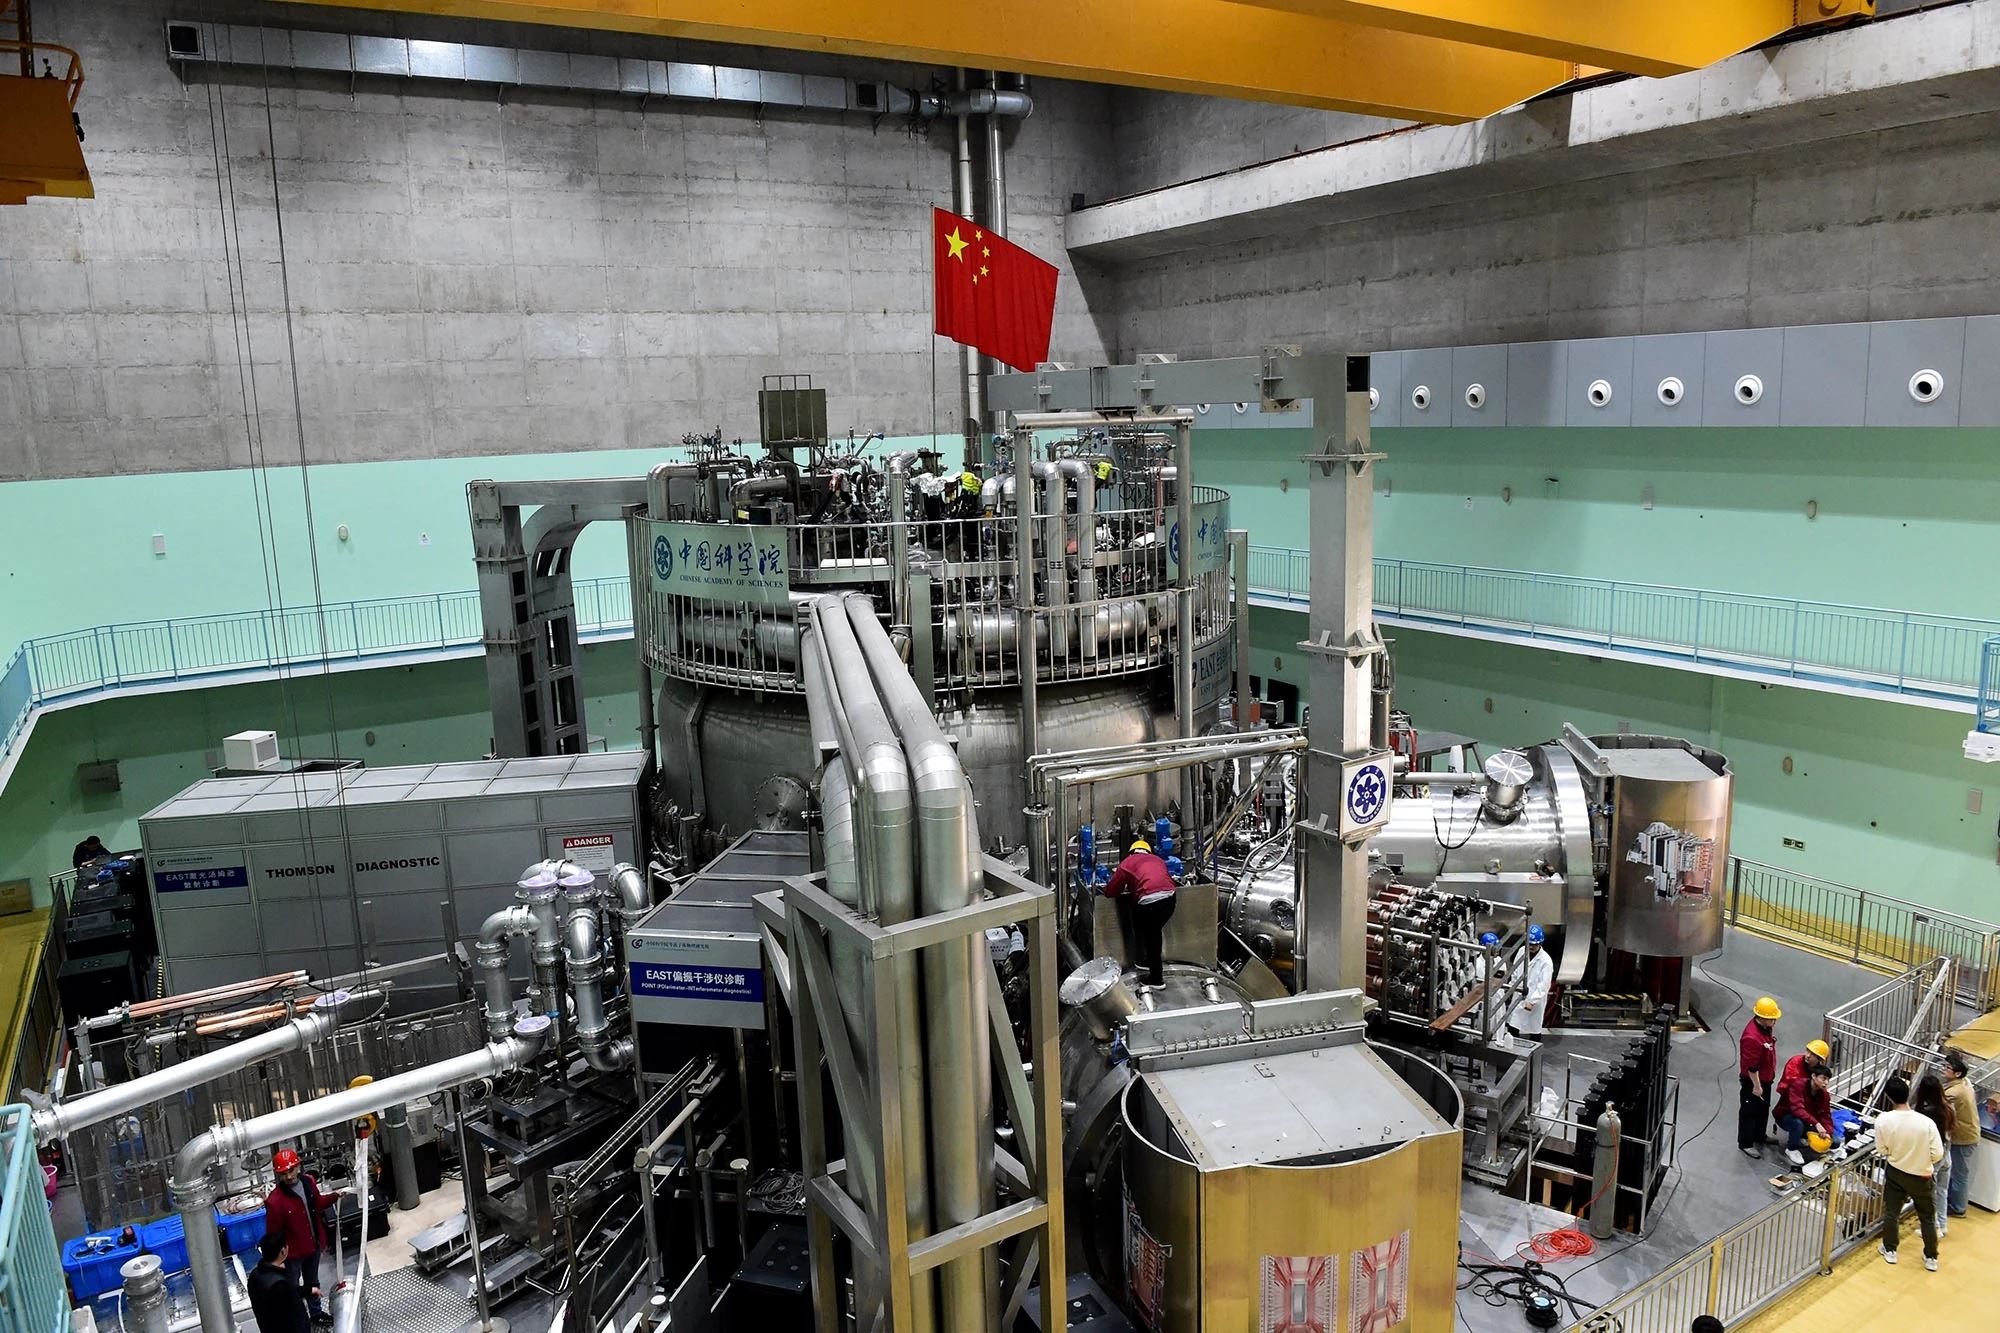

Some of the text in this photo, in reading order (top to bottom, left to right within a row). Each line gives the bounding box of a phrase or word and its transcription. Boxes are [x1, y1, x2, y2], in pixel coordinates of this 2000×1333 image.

[678, 538, 784, 576] 中国科学院
[680, 575, 702, 583] CHINESE
[704, 577, 733, 586] ACADEMY
[748, 579, 784, 588] SCIENCES
[574, 837, 611, 846] DANGER
[265, 856, 441, 879] THOMSON DIAGNOSTIC
[646, 970, 745, 985] EAST偏振干涉仪诊断
